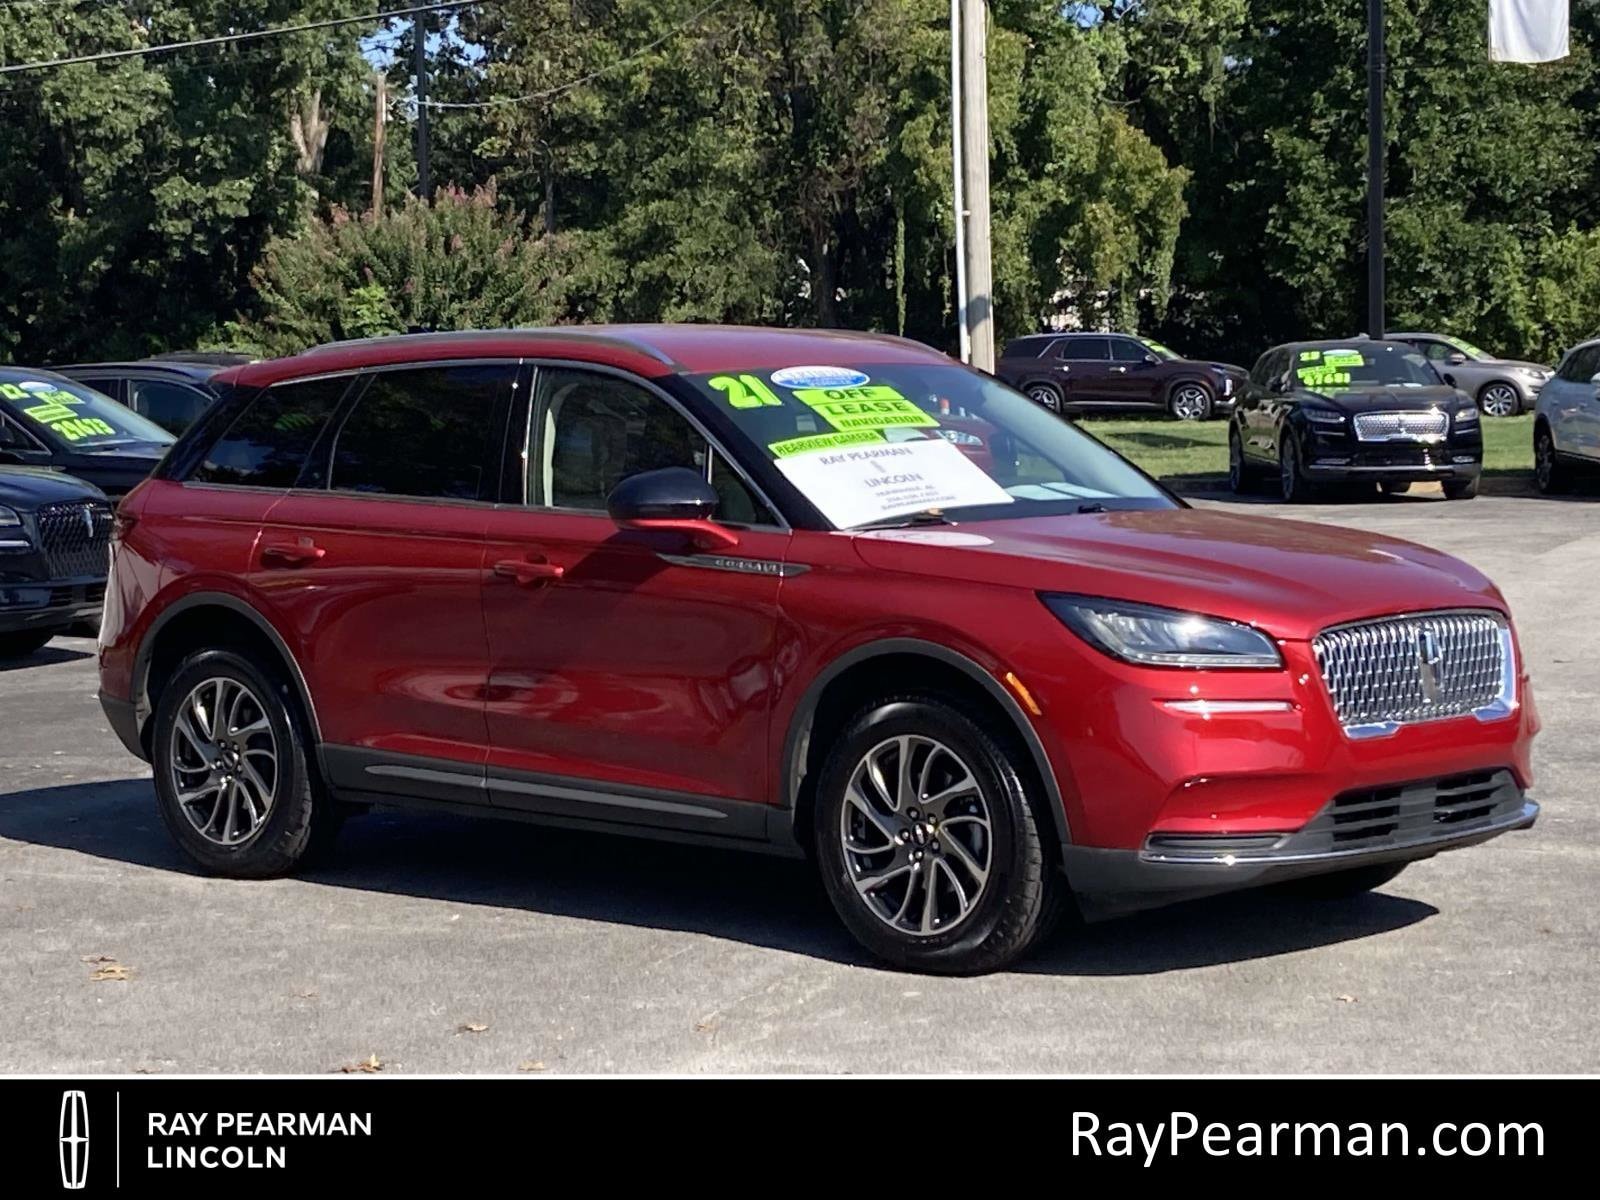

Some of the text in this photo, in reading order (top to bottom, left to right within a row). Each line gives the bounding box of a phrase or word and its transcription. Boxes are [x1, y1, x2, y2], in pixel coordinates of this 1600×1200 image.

[708, 374, 783, 410] 21
[823, 388, 879, 401] OFF
[826, 401, 911, 416] LEASE
[839, 415, 926, 427] NAVIGATION
[774, 431, 881, 455] REARVIEW CAMERA
[819, 447, 914, 466] RAY PEARMAN
[864, 472, 924, 488] LINCOLN
